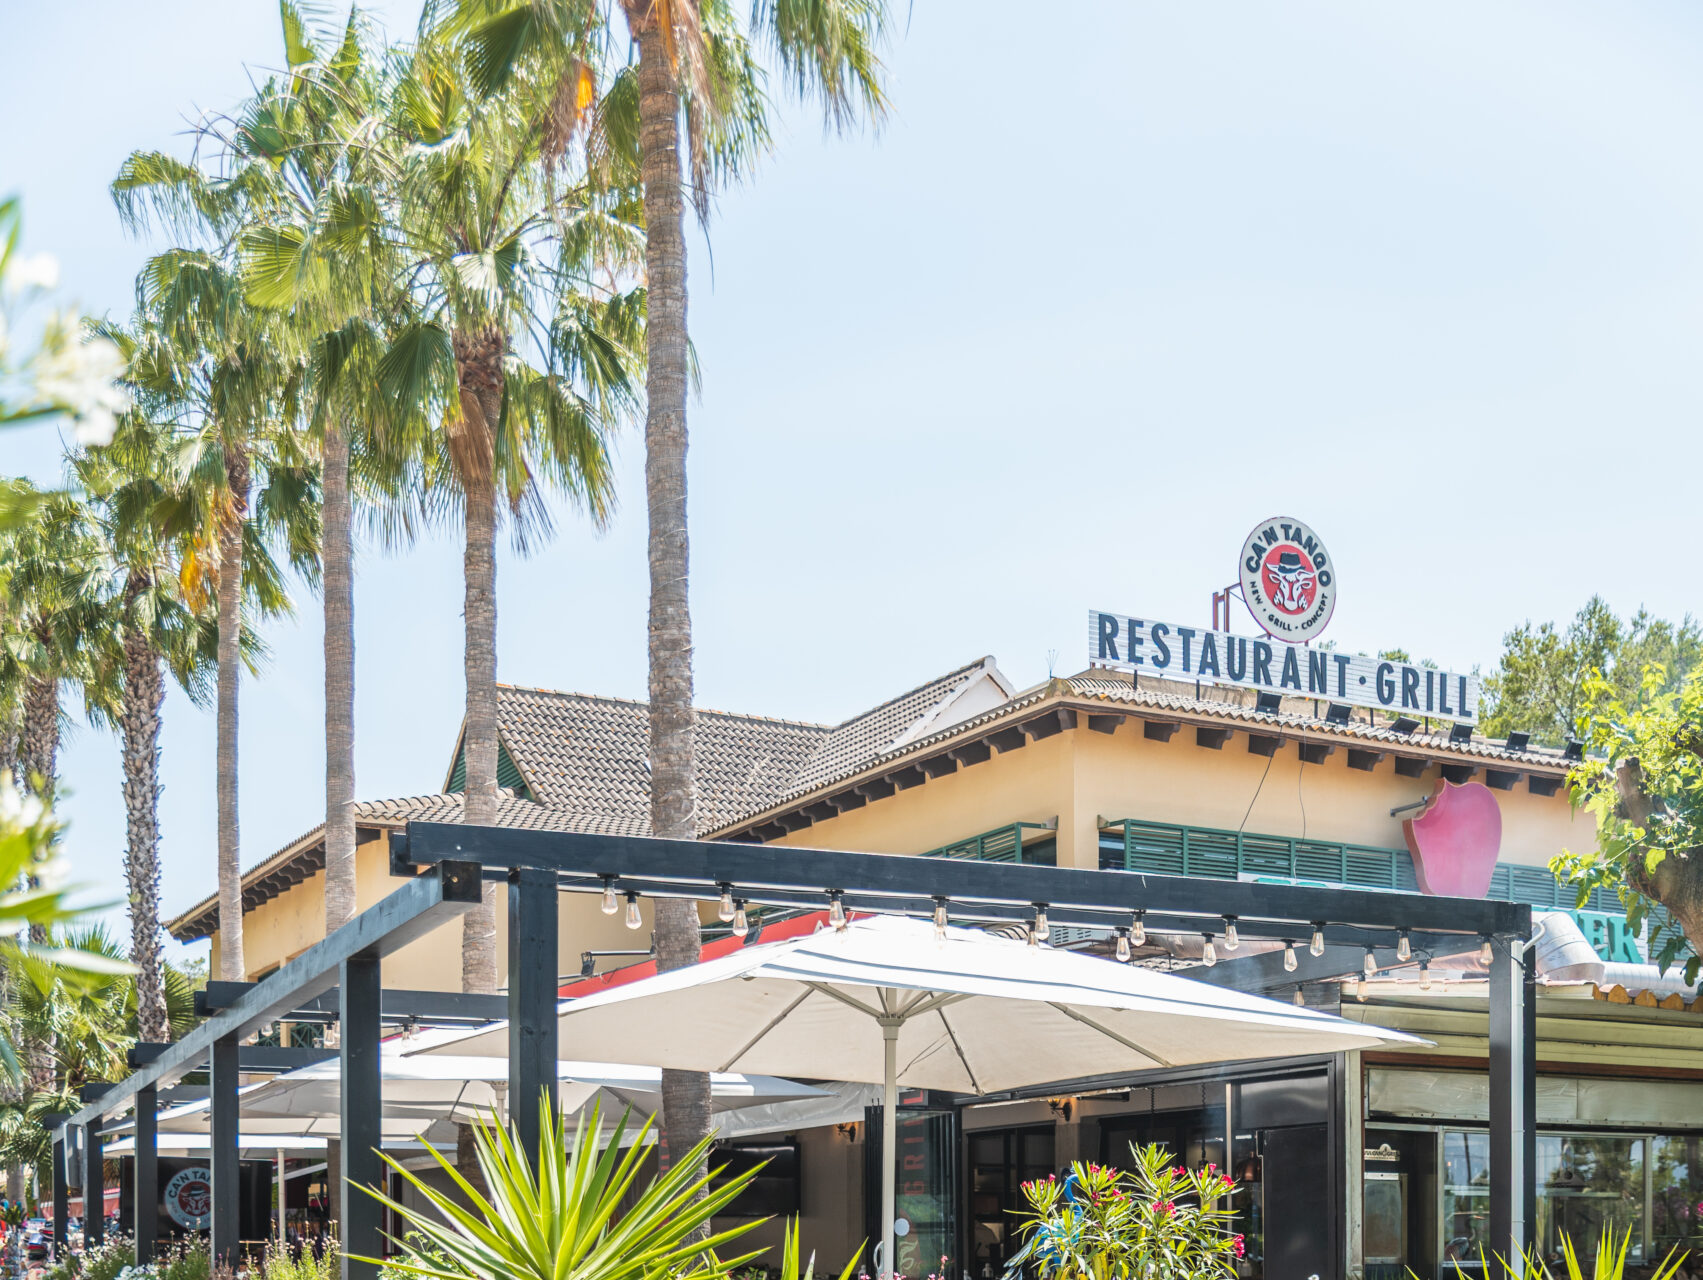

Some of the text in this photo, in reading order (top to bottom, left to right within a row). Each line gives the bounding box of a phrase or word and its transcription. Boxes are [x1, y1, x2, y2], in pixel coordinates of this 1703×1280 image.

[1246, 524, 1331, 587] CA'N TANGO
[1250, 581, 1328, 631] NEW GRILL CONCEPT
[1098, 613, 1473, 718] RESTAURANT GRILL
[168, 1173, 190, 1198] CA'N
